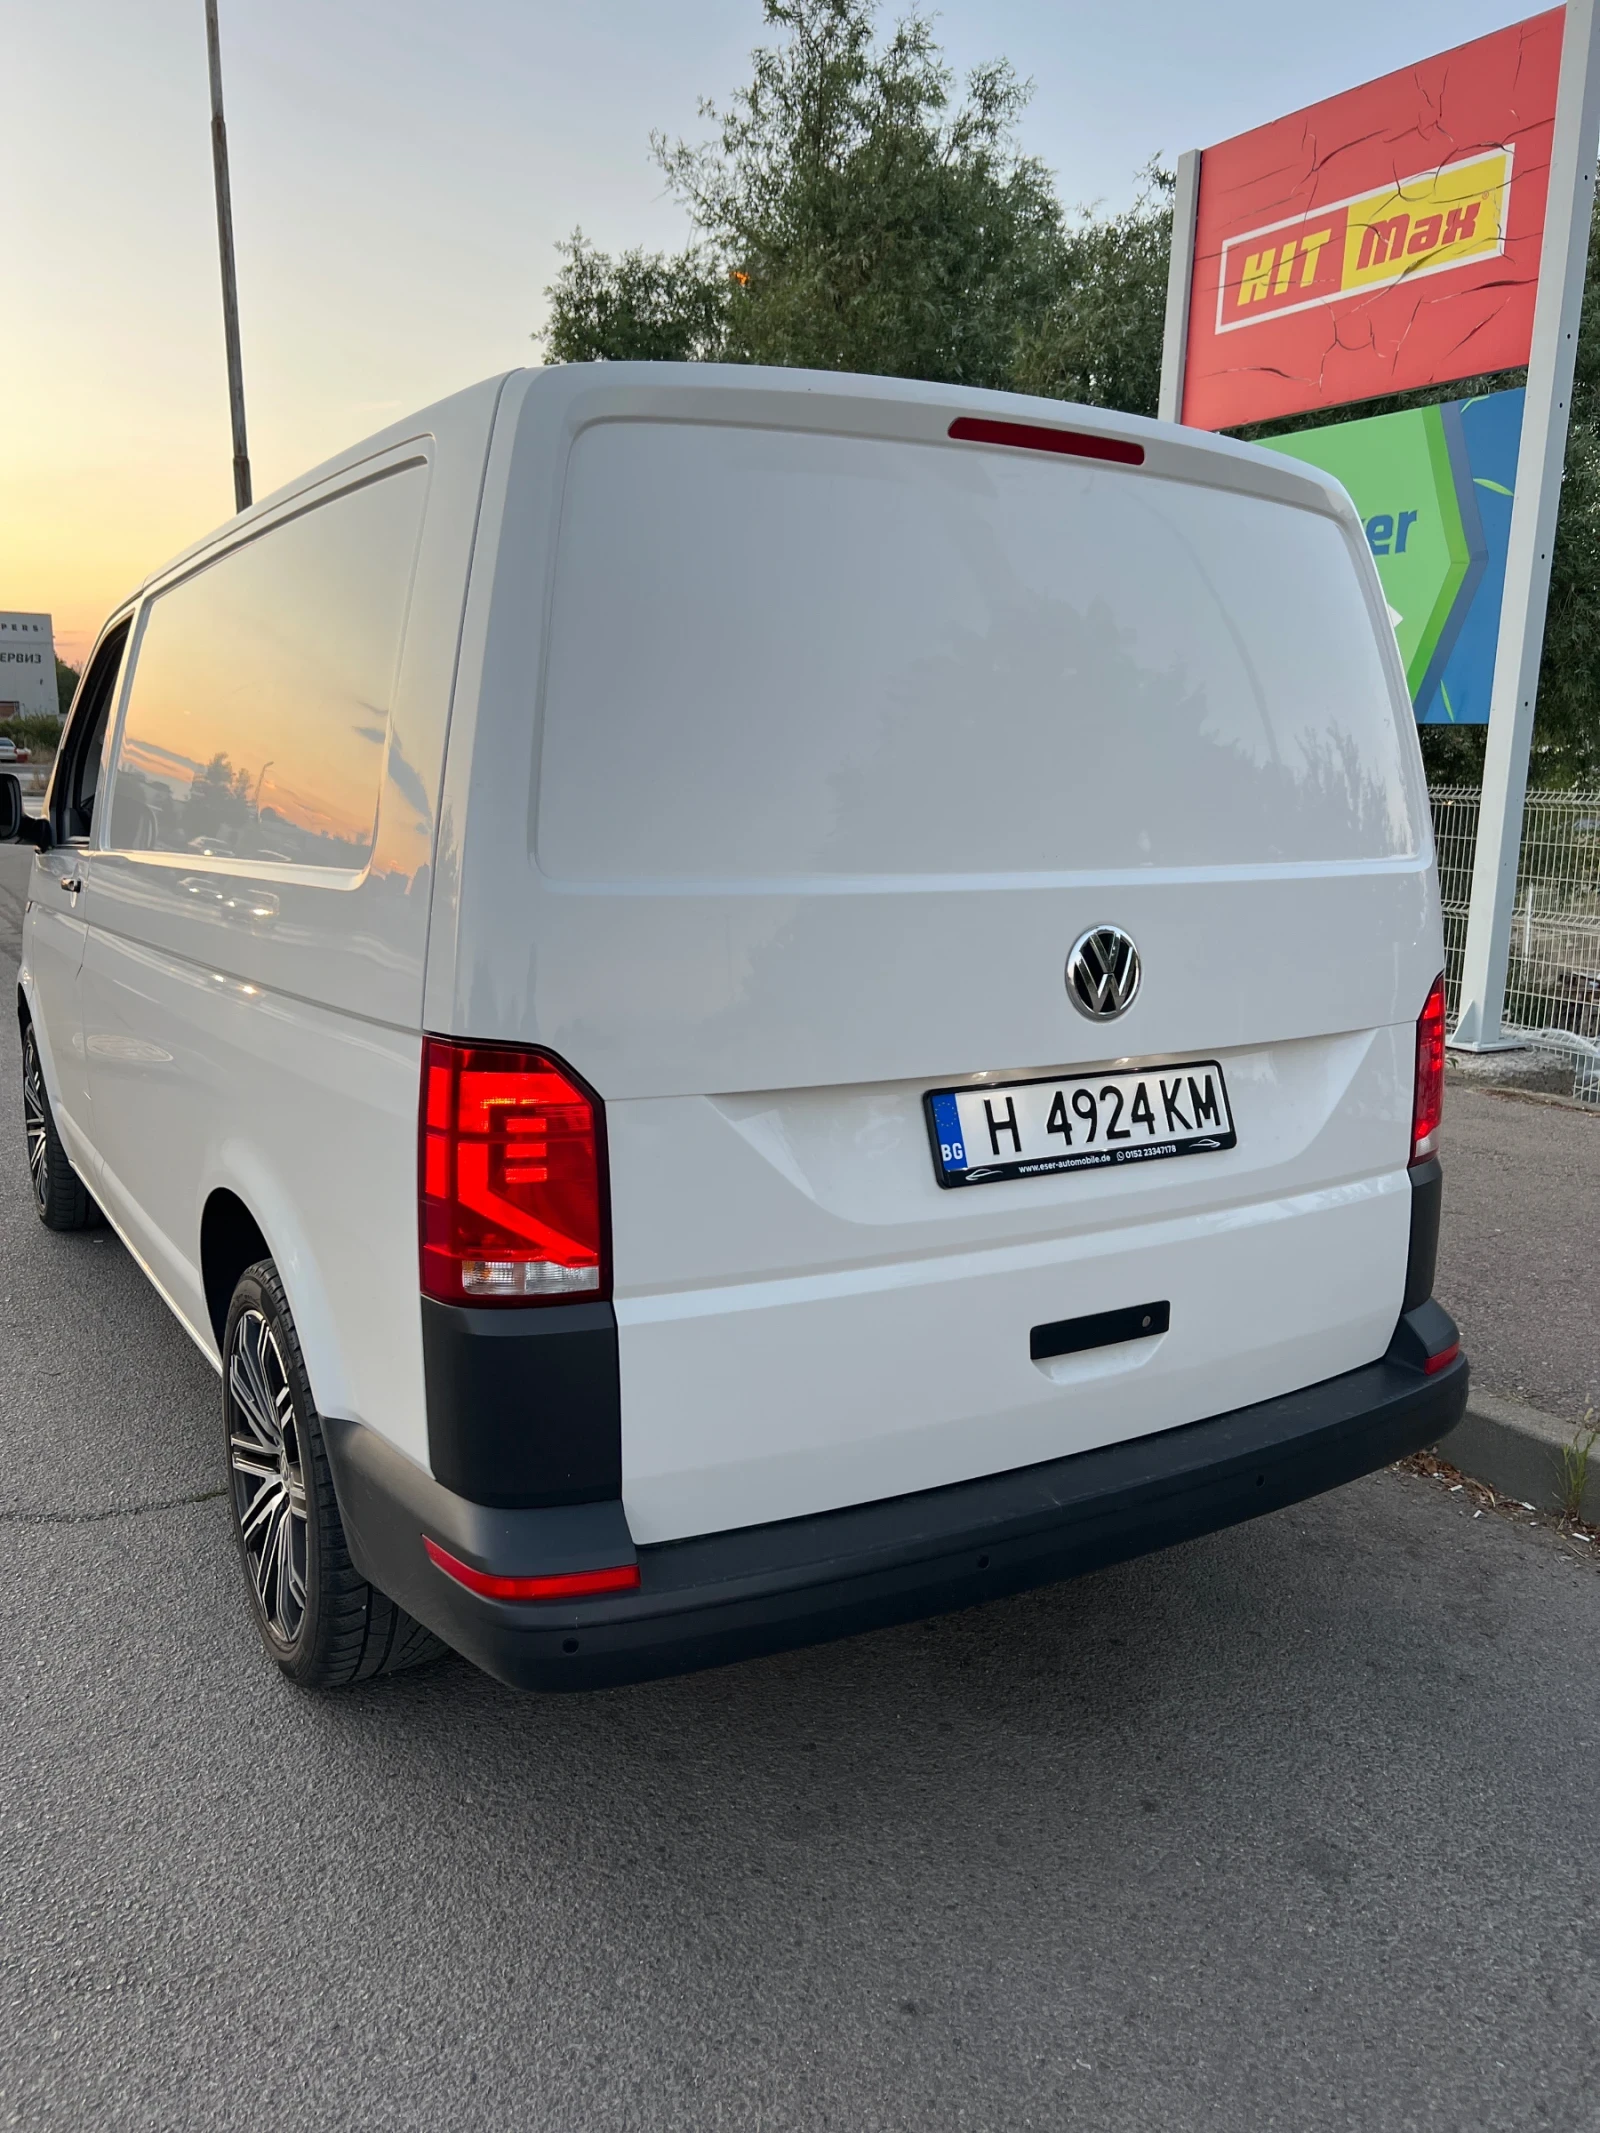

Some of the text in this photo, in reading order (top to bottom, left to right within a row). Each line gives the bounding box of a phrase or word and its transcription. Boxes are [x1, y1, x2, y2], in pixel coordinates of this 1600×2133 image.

[1237, 228, 1332, 306] HIT
[1360, 509, 1418, 556] er
[983, 1096, 1022, 1156] H
[941, 1144, 963, 1162] BG
[1018, 1144, 1177, 1173] www.eser-automobile.de 0152 23347178
